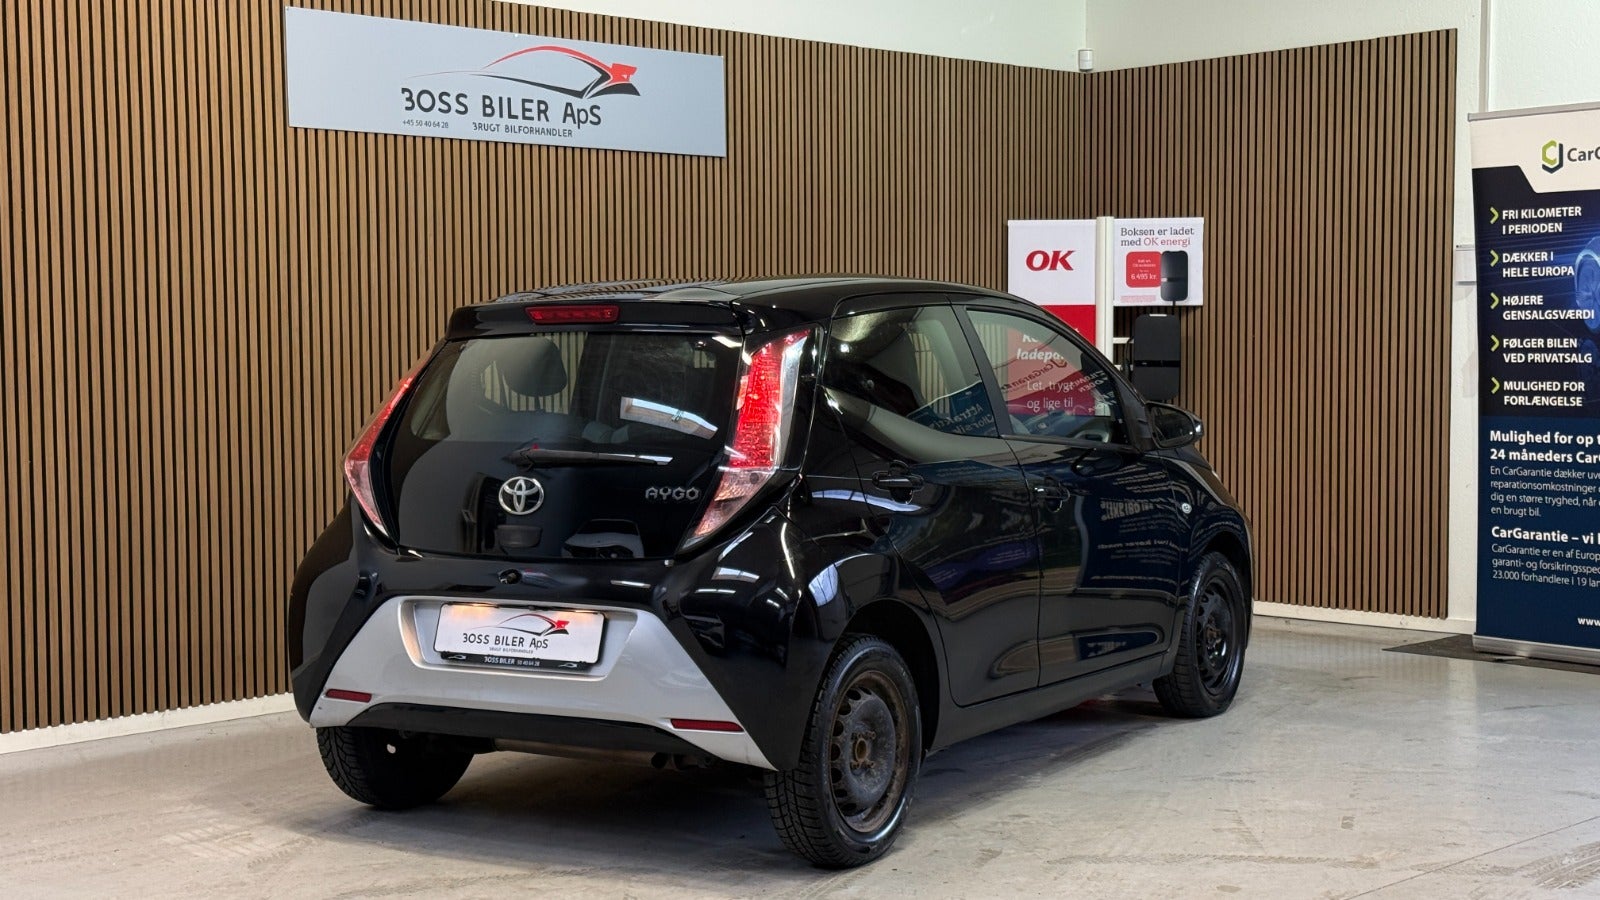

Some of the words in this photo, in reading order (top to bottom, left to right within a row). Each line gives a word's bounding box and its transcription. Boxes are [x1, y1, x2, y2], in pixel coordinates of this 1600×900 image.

[482, 95, 549, 122] BILER
[562, 102, 602, 129] ApS
[504, 125, 573, 138] BILFORHANDLER
[1502, 209, 1518, 220] FRI
[1521, 206, 1582, 219] KILOMETER
[1120, 227, 1155, 236] Boksen
[1170, 227, 1195, 236] ladet
[1502, 225, 1506, 235] I
[1508, 222, 1562, 234] PERIODEN
[1120, 238, 1141, 246] med
[1143, 237, 1159, 246] OK
[1160, 237, 1191, 247] energi
[1025, 250, 1075, 271] OK
[1502, 251, 1548, 263] DÆKKER
[1550, 251, 1554, 261] I
[1502, 267, 1529, 278] HELE
[1531, 266, 1575, 277] EUROPA
[1502, 295, 1544, 306] HØJERE
[1502, 309, 1595, 320] GENSALGSVÆRDI
[1503, 338, 1545, 349] FØLGER
[1547, 338, 1578, 348] BILEN
[1016, 348, 1064, 362] ladepa
[1503, 353, 1526, 363] VED
[1527, 353, 1593, 363] PRIVATSALG
[1503, 381, 1561, 391] MULIGHED
[1563, 381, 1585, 392] FOR
[1026, 399, 1040, 413] og
[1043, 397, 1061, 411] lige
[1064, 397, 1074, 408] til
[1503, 395, 1583, 407] FORLÆNGELSE
[1489, 430, 1551, 446] Mulighed
[1554, 432, 1574, 444] for
[1576, 435, 1594, 448] op
[1489, 448, 1506, 460] 24
[1508, 448, 1573, 462] måneders
[1576, 451, 1600, 464] Car
[1490, 465, 1500, 475] En
[1502, 466, 1552, 478] CarGarantie
[1553, 468, 1585, 479] dækker
[645, 486, 699, 500] AYGO
[1490, 480, 1596, 495] reparationsomkostninger
[1490, 491, 1504, 504] dig
[1505, 494, 1517, 502] en
[1519, 494, 1543, 504] større
[1545, 495, 1581, 507] tryghed,
[1582, 496, 1597, 507] når
[1490, 506, 1502, 514] en
[1503, 505, 1527, 518] brugt
[1528, 507, 1541, 517] bil.
[1491, 526, 1569, 543] CarGarantie
[1582, 532, 1594, 545] vi
[1491, 543, 1540, 556] CarGarantie
[1542, 549, 1551, 557] er
[1552, 550, 1564, 558] en
[1565, 548, 1575, 559] af
[1492, 558, 1525, 568] garanti-
[1525, 561, 1538, 571] og
[1492, 569, 1520, 581] 23.000
[1521, 571, 1570, 585] forhandlere
[1577, 576, 1587, 587] 19
[494, 635, 525, 648] BILER
[529, 637, 549, 650] ApS
[499, 657, 515, 665] BILER
